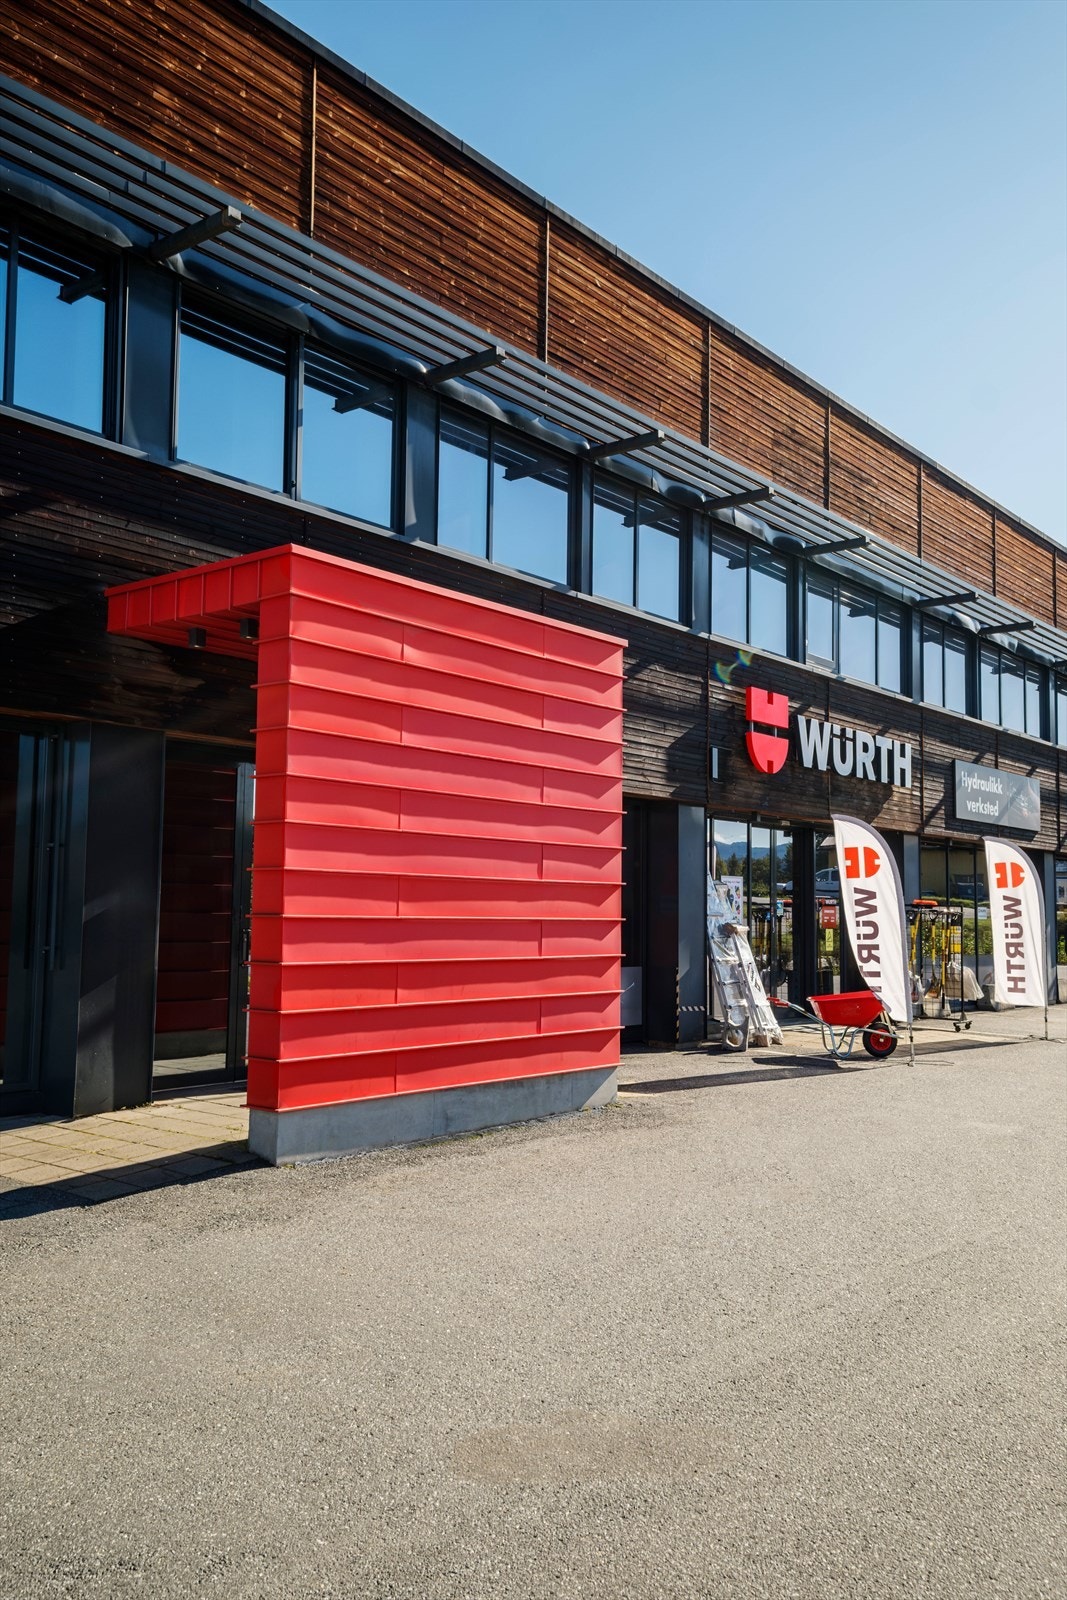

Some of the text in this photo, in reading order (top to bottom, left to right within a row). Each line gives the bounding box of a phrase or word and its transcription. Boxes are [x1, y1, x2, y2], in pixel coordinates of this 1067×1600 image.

[797, 714, 912, 789] WÜRTH
[961, 770, 1003, 795] Hydraulikk
[966, 797, 999, 817] verksted
